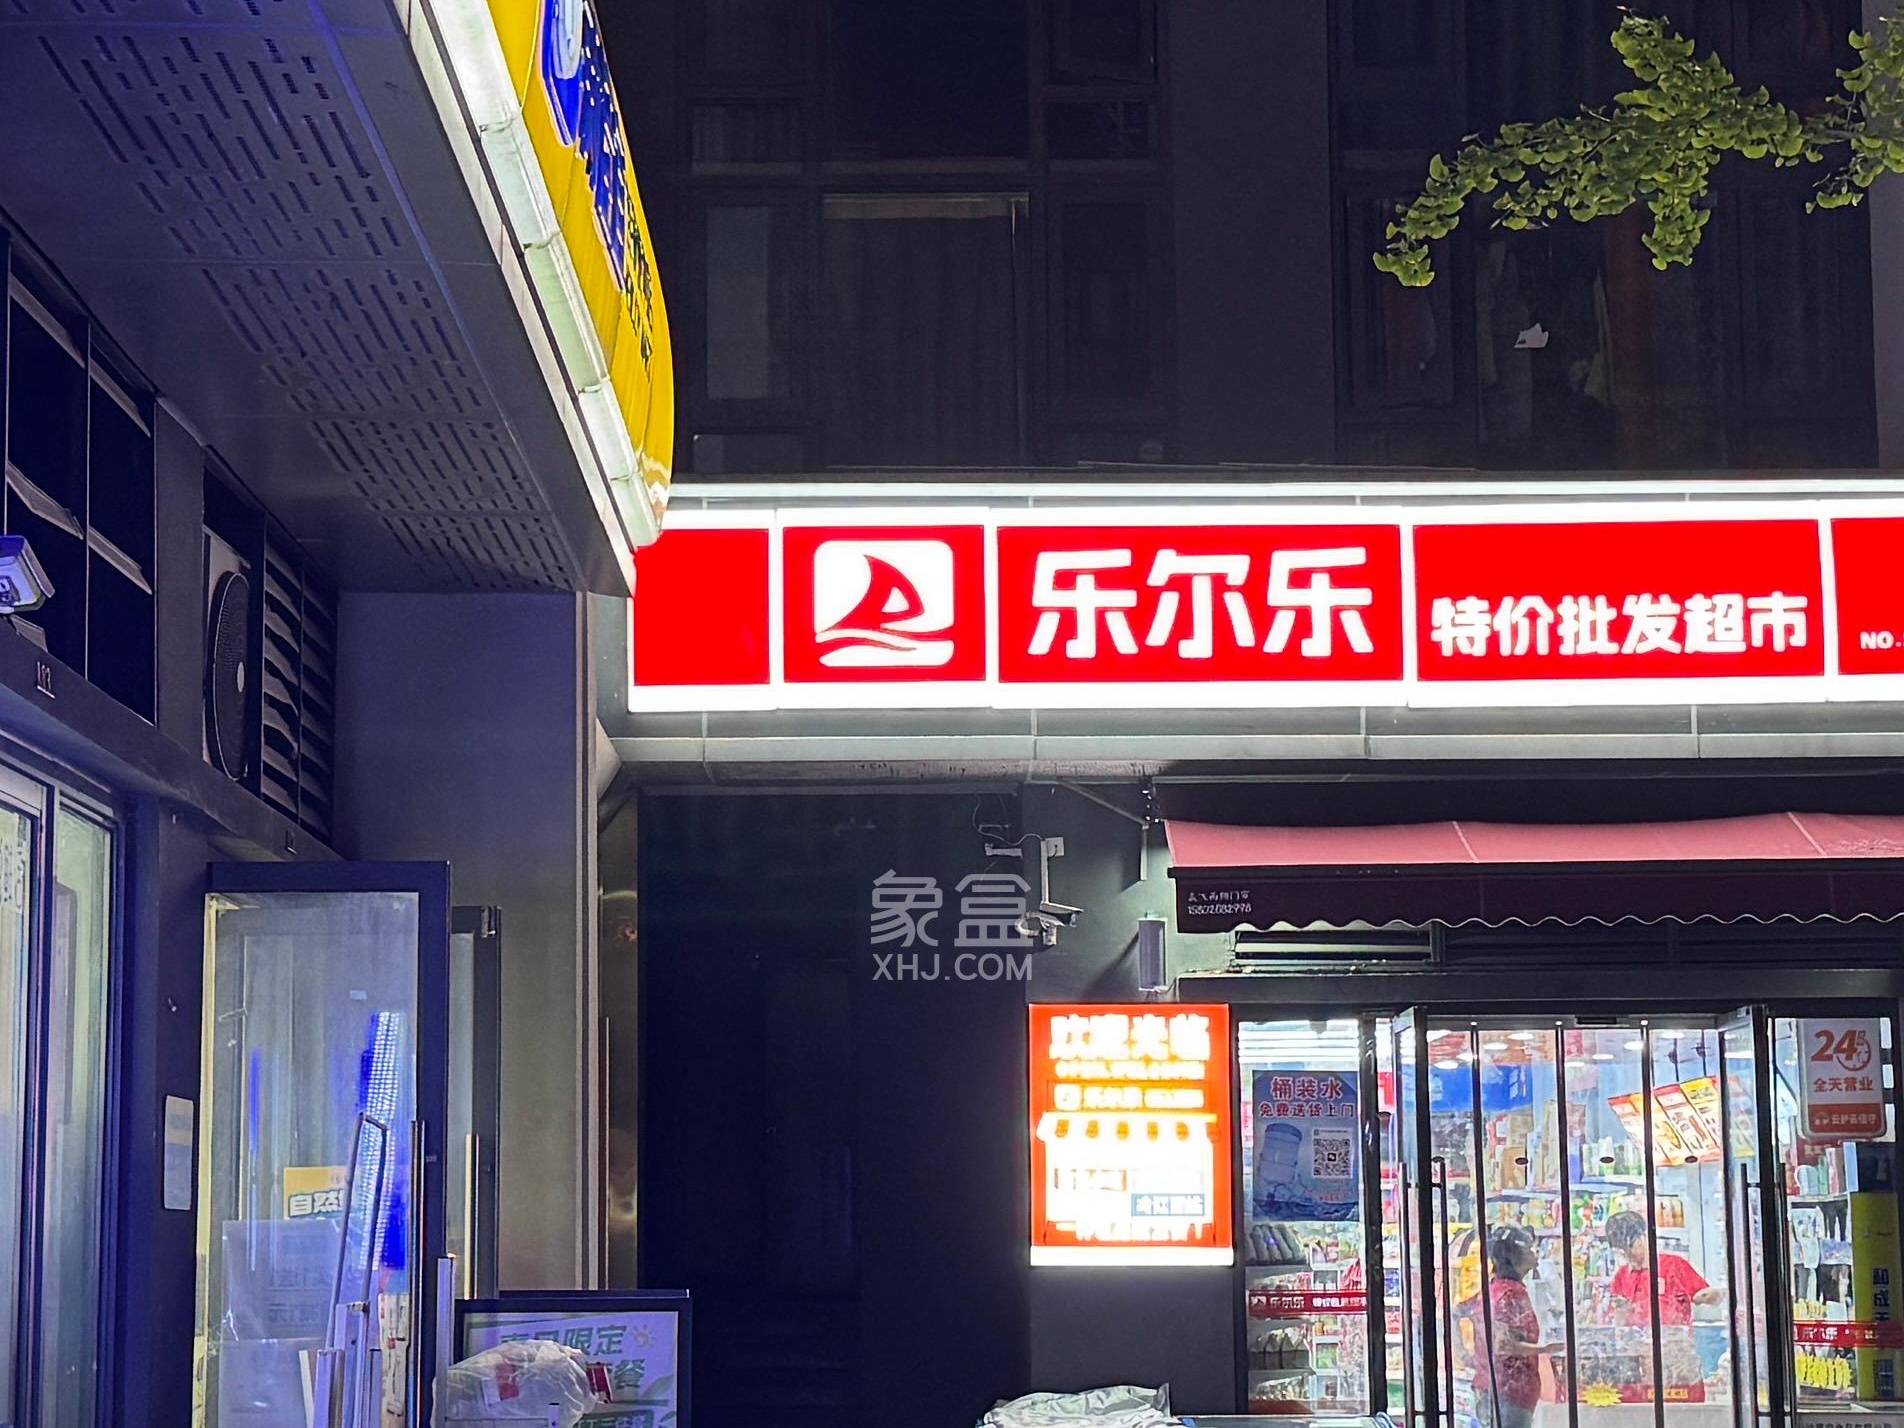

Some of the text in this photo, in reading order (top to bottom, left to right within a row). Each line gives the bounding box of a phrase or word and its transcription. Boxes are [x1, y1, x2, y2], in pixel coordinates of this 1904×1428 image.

[1027, 546, 1374, 659] 乐尔乐
[1429, 592, 1809, 657] 特价批发超市
[1270, 1076, 1343, 1100] 桶装水
[1813, 1076, 1875, 1093] 全天营业
[1259, 1102, 1355, 1118] 免费送货上门
